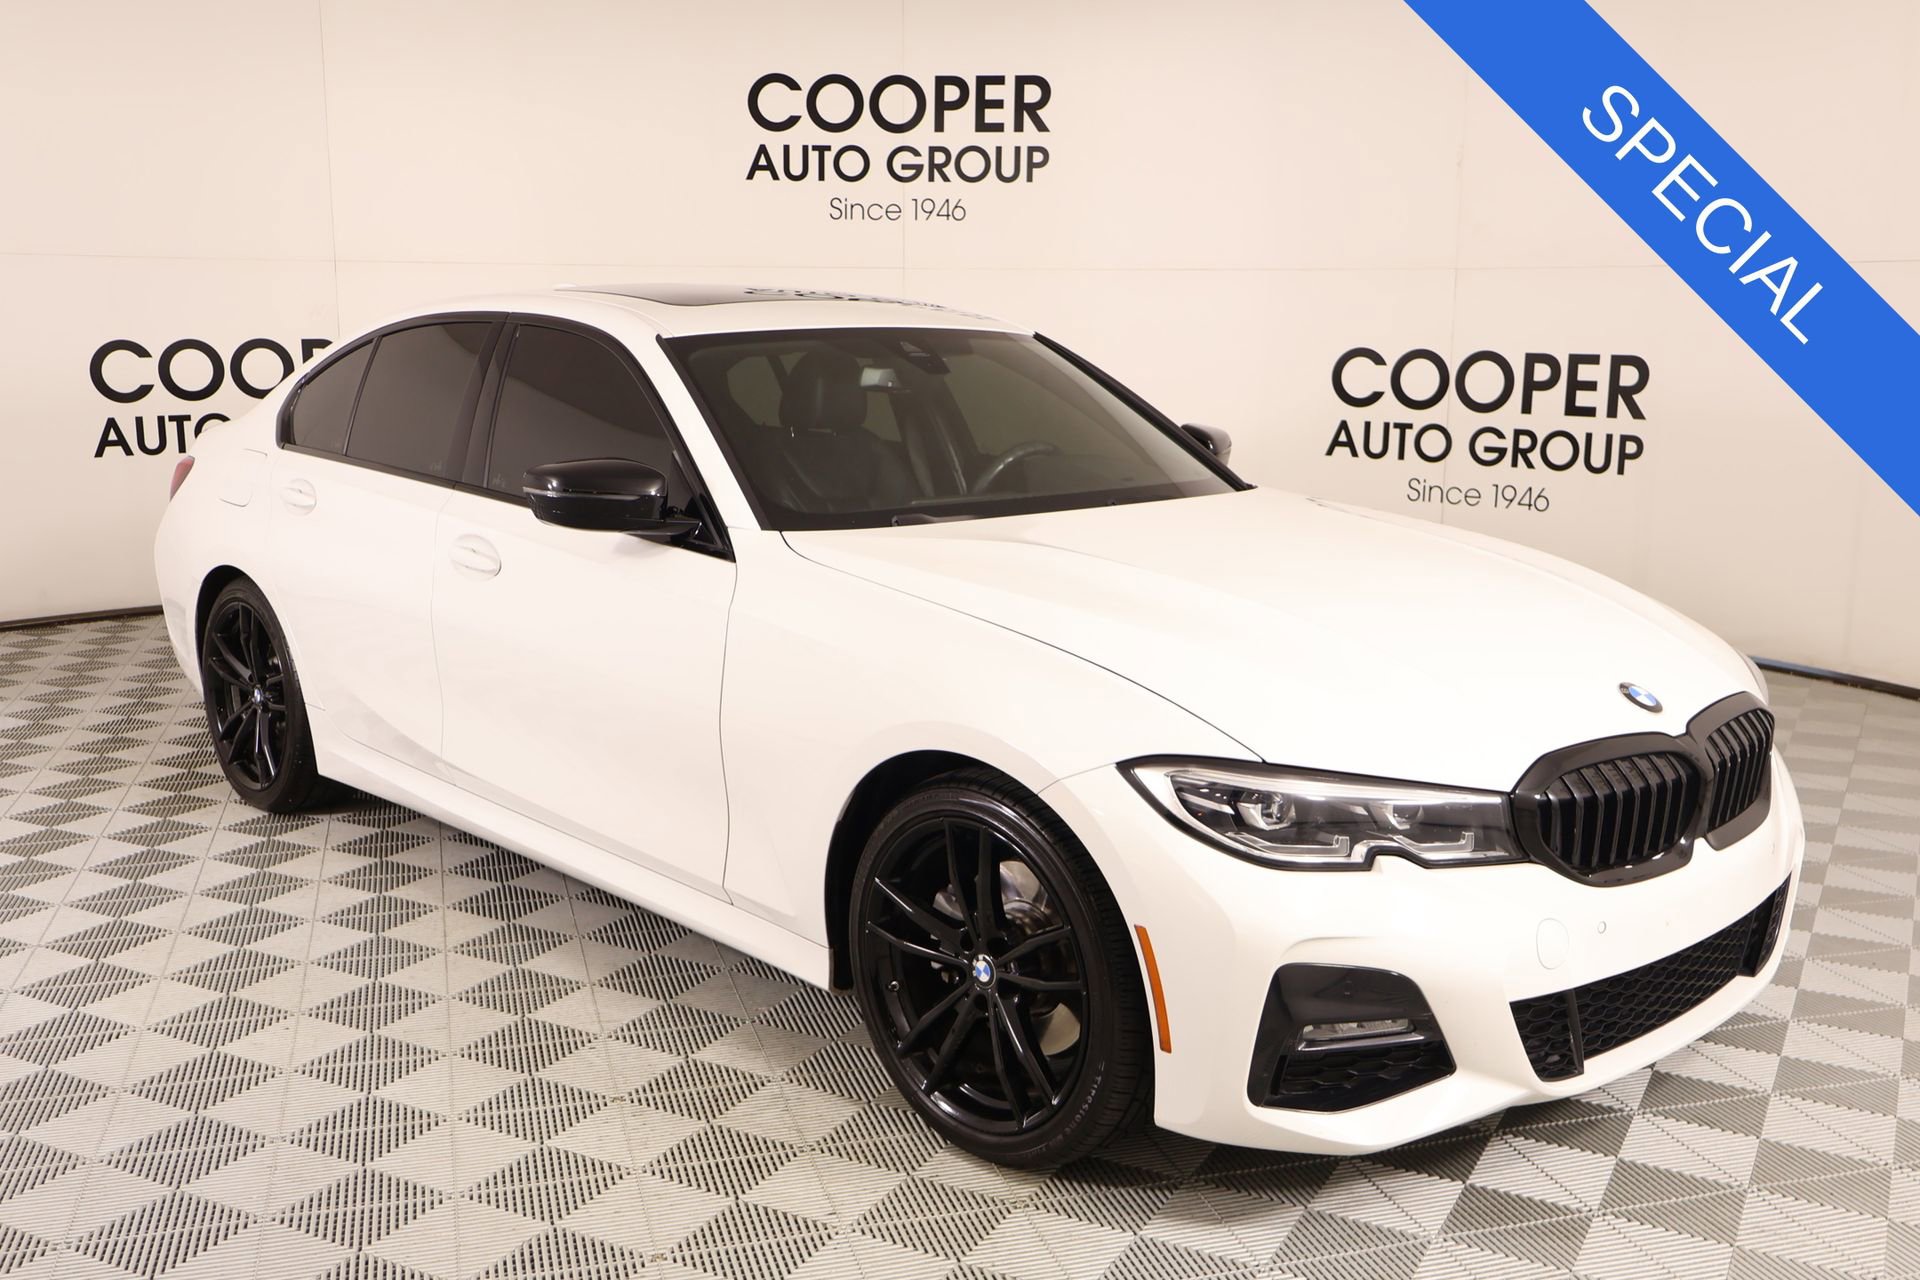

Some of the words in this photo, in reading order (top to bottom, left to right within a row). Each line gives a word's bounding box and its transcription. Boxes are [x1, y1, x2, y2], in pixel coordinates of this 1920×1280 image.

[747, 72, 1052, 135] COOPER
[745, 143, 871, 183] AUTO
[886, 144, 1050, 184] GROUP
[829, 196, 902, 221] Since
[911, 197, 967, 222] 1946
[1331, 346, 1651, 421] COOPER
[1324, 419, 1453, 464] AUTO
[1468, 425, 1645, 476] GROUP
[1406, 477, 1482, 507] Since
[1492, 483, 1550, 513] 1946
